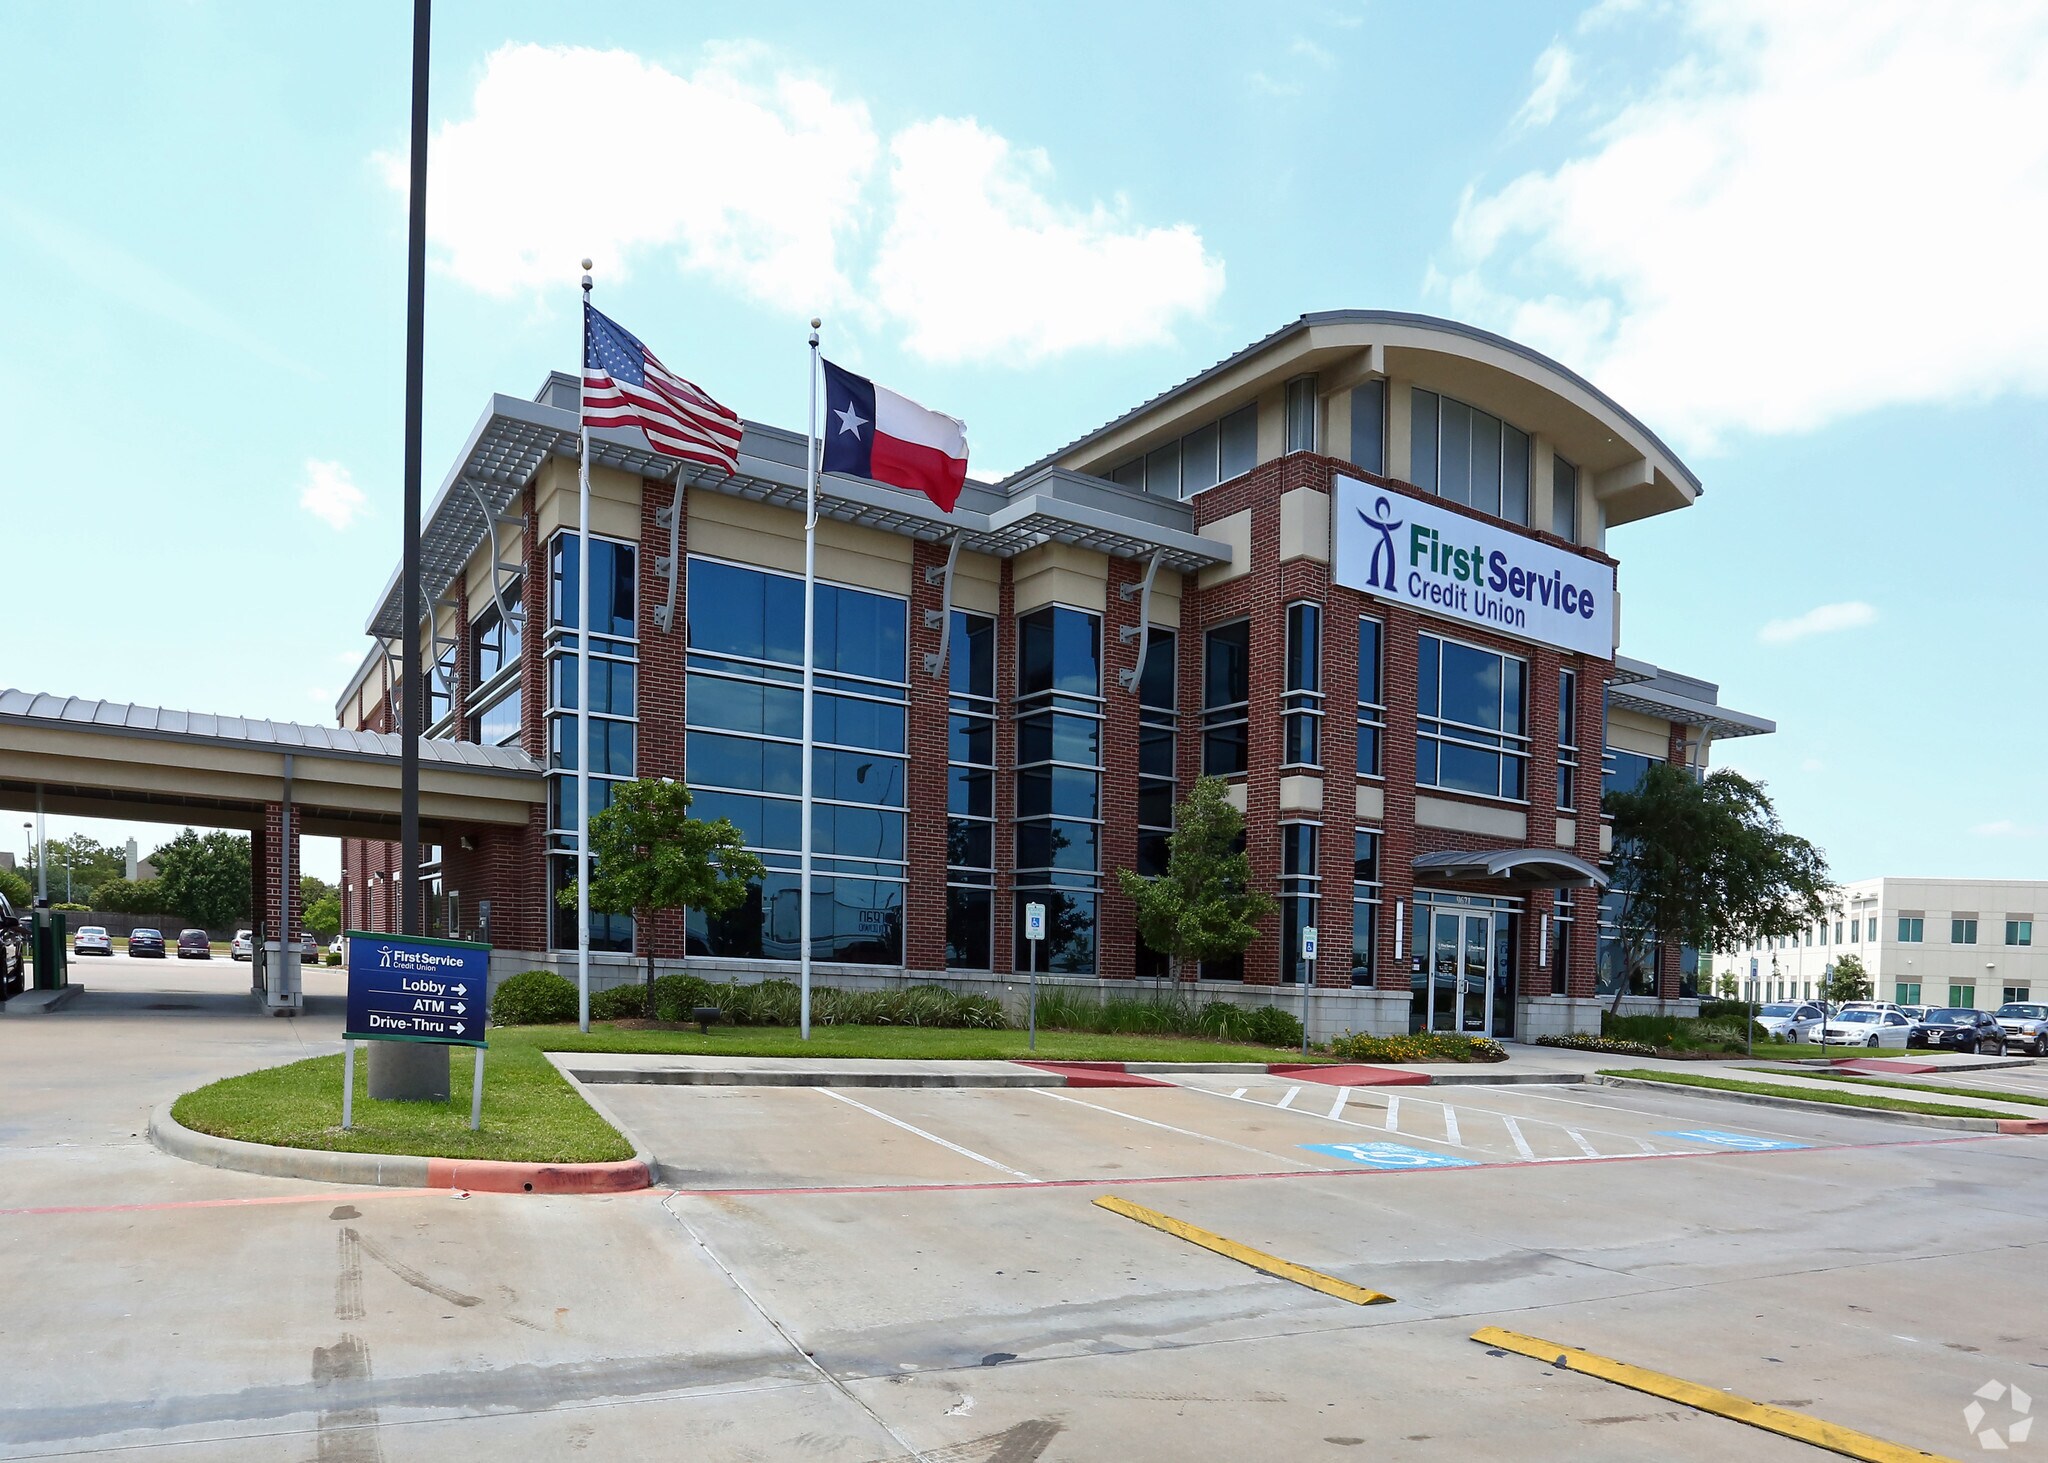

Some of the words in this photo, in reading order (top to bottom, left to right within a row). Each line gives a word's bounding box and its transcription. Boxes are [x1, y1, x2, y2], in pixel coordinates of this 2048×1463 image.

[1410, 523, 1484, 587] First
[1487, 550, 1595, 620] Service
[1408, 571, 1468, 613] Credit
[1473, 589, 1526, 629] Union
[393, 962, 415, 970] Credit
[416, 963, 437, 972] Union
[394, 950, 421, 963] First
[421, 953, 464, 967] Service
[402, 977, 446, 996] Lobby
[413, 999, 445, 1013] ATM
[369, 1014, 444, 1033] Drive-Thru
